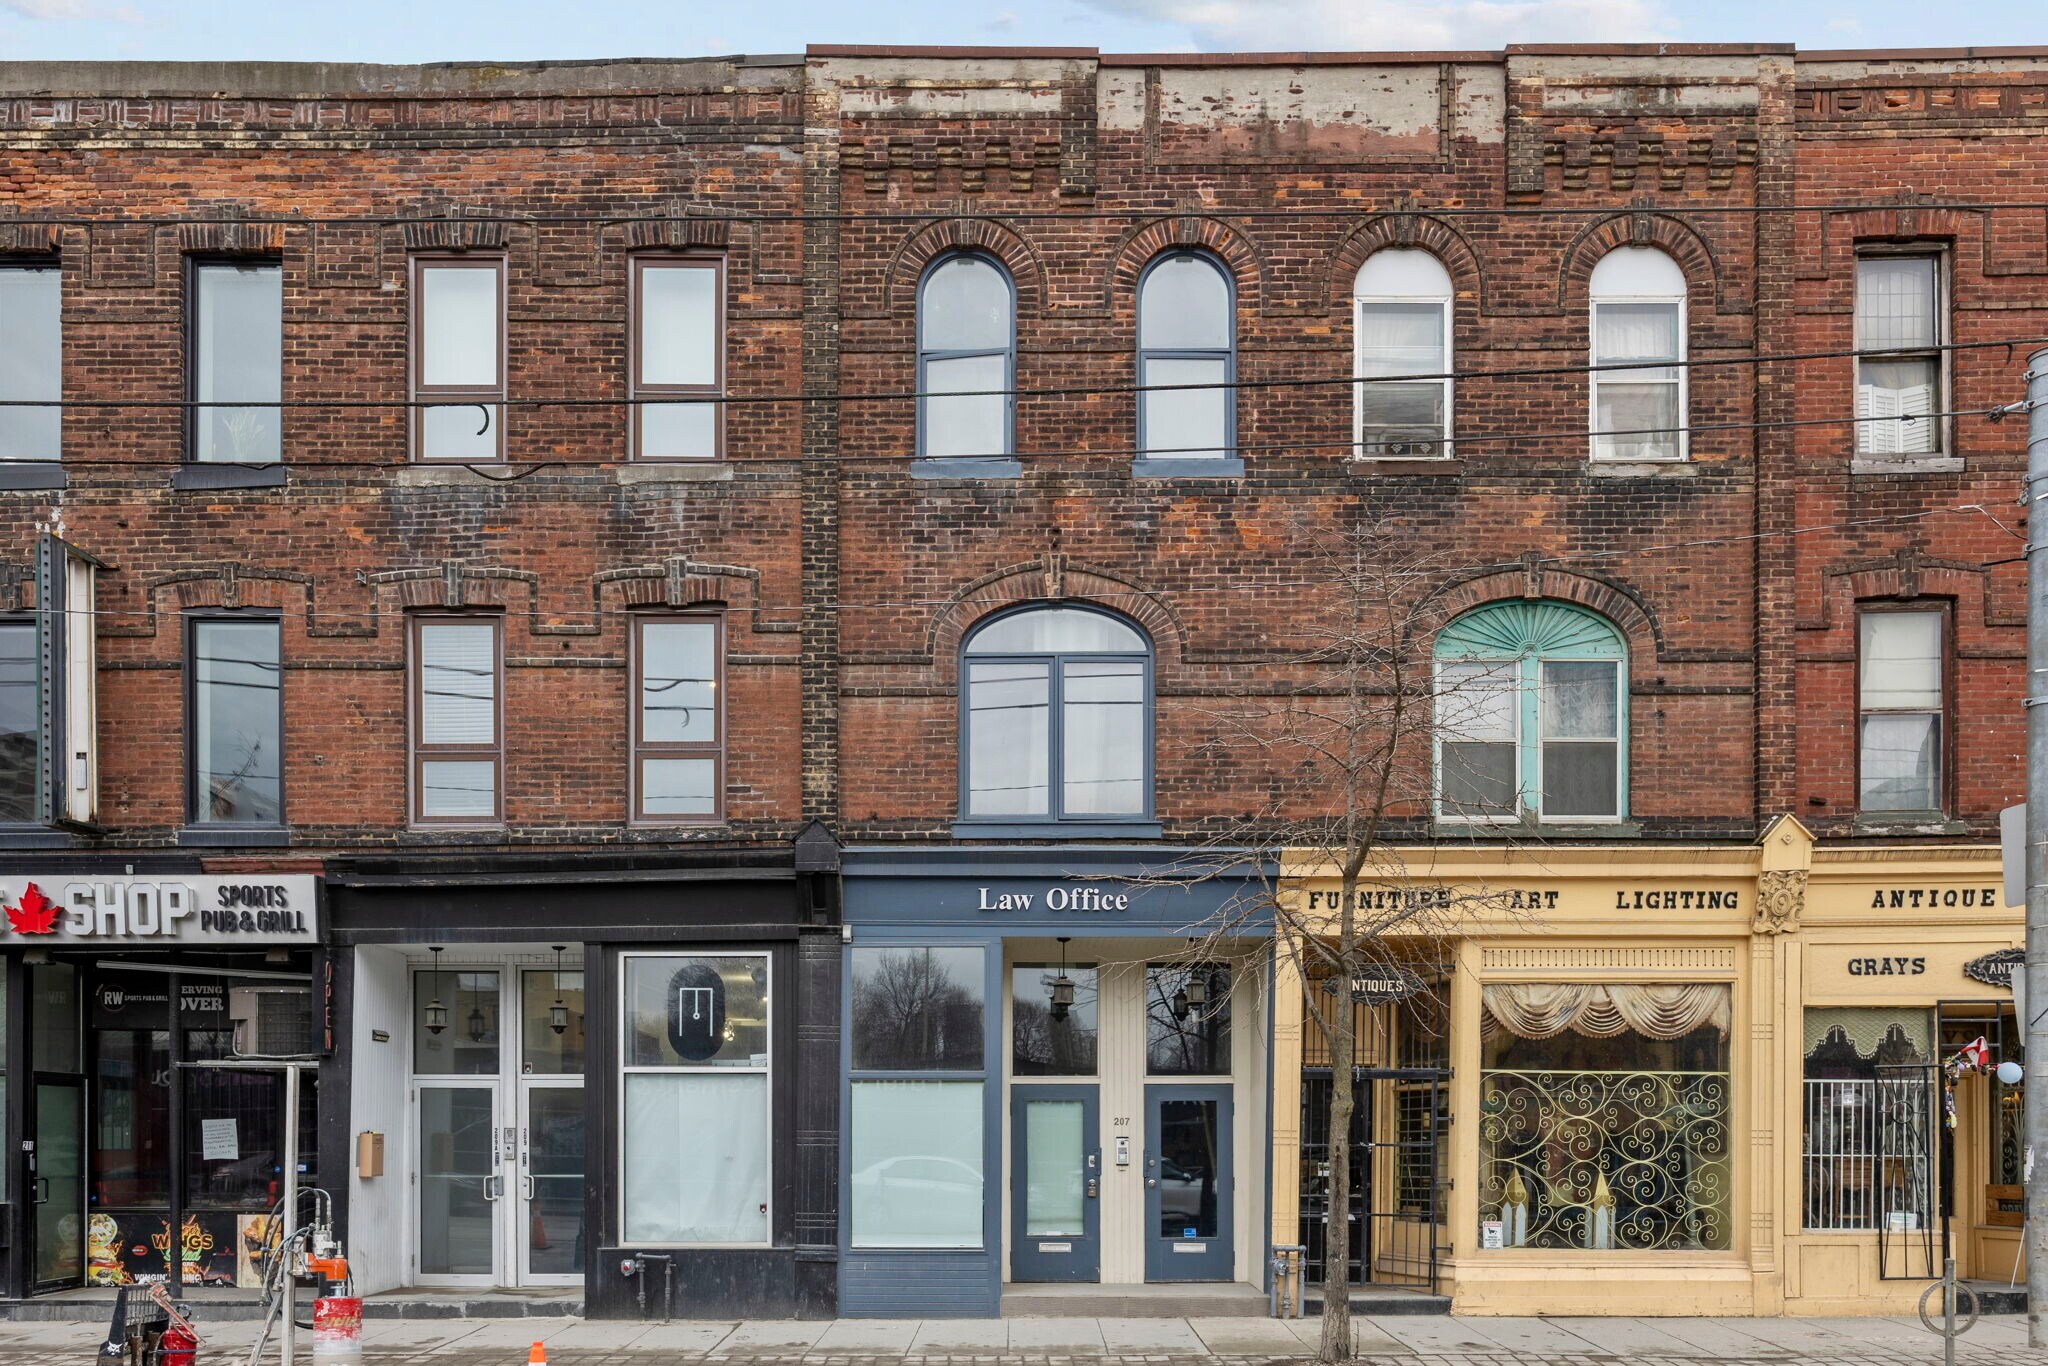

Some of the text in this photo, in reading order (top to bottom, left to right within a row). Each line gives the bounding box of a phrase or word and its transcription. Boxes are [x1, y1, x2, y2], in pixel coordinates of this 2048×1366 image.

[218, 885, 287, 907] SPORTS
[978, 887, 1129, 911] Law Office
[1309, 891, 1738, 909] FUNITURE ART LIGHTING
[1871, 889, 1996, 908] ANTIQUE
[64, 882, 192, 935] SHOP
[1848, 957, 1925, 976] GRAYS
[181, 985, 223, 994] ERVING
[1352, 980, 1403, 992] NTIQUES
[104, 991, 123, 1005] RW
[1114, 1117, 1130, 1126] 207
[151, 1234, 213, 1250] WNGS
[182, 1273, 202, 1281] SINC
